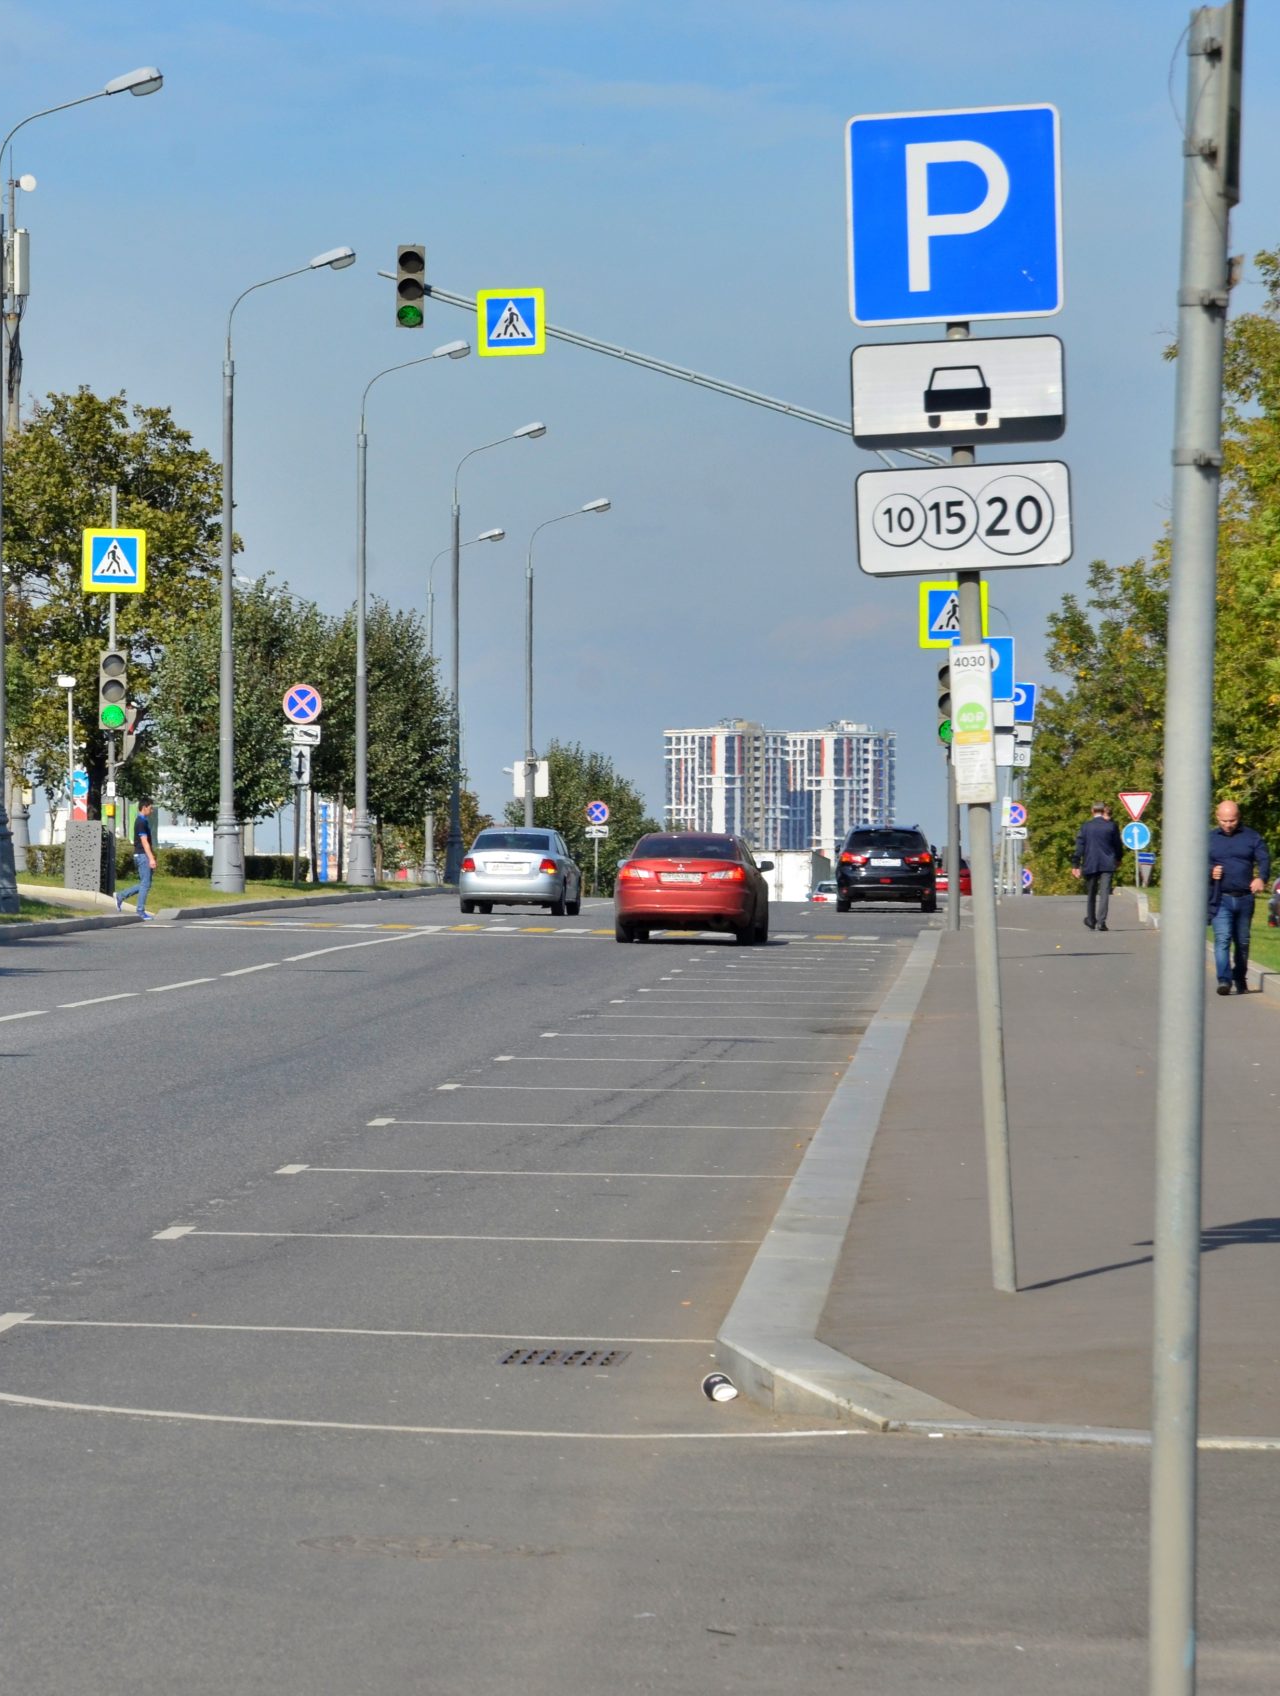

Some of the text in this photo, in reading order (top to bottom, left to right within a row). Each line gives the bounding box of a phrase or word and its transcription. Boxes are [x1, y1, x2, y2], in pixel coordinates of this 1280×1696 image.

[905, 140, 1010, 292] P
[883, 495, 1042, 537] 10 15 20
[953, 655, 986, 668] 4030
